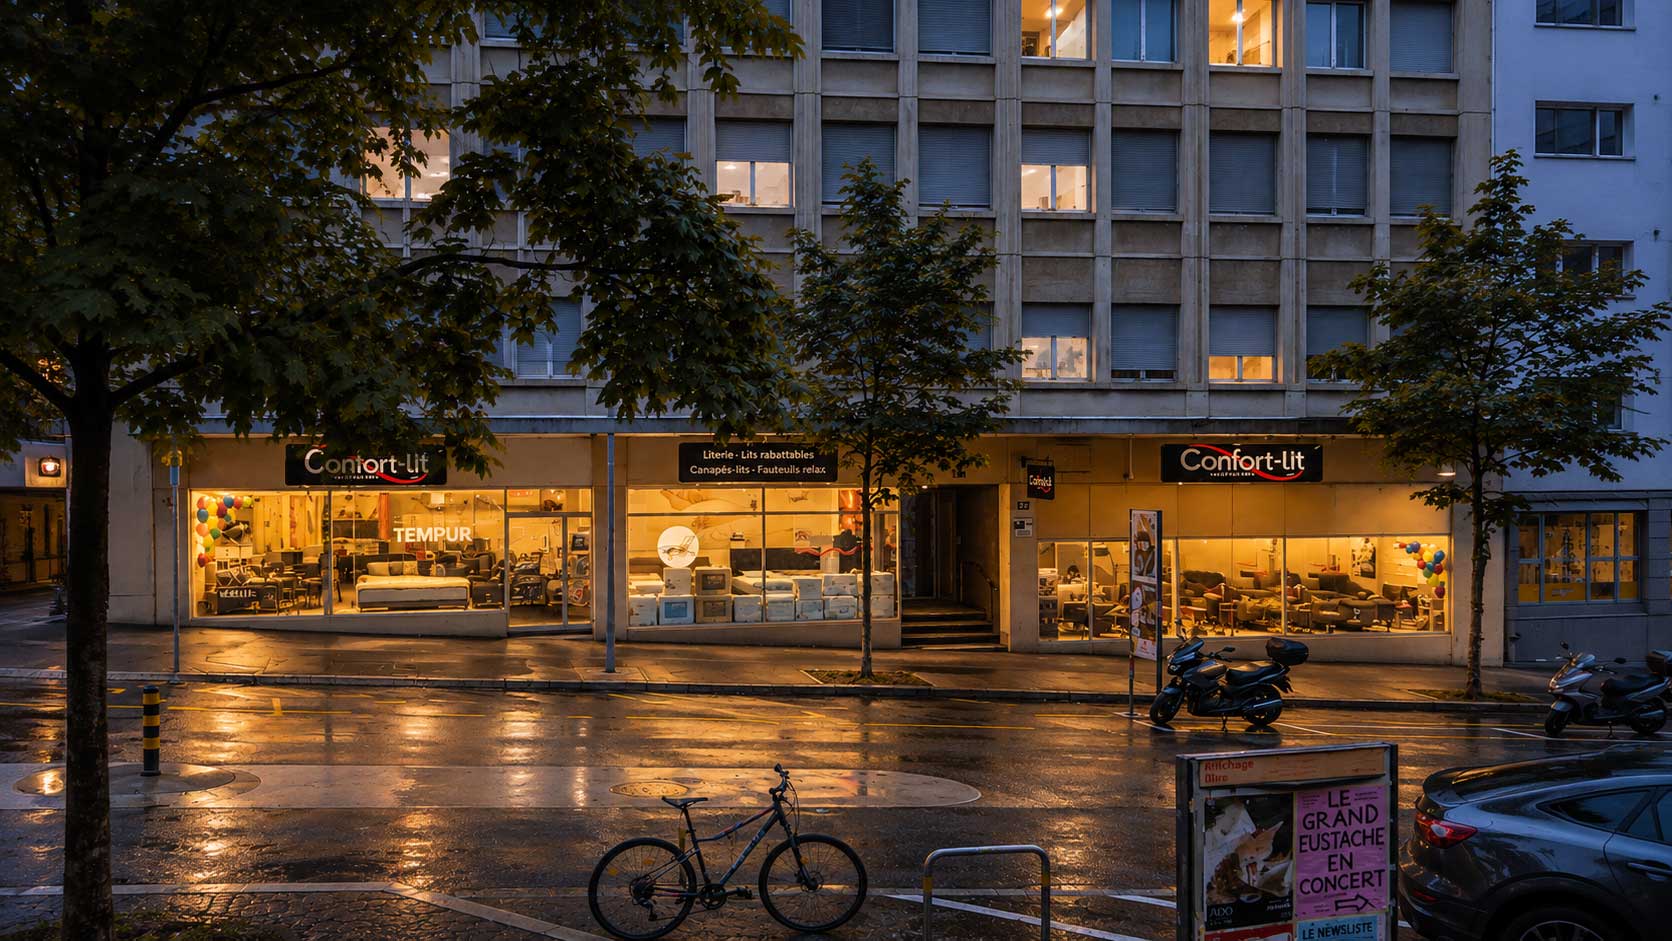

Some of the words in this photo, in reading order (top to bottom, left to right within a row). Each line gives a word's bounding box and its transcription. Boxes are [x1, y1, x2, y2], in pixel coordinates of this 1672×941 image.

[304, 448, 429, 474] Confort-lit
[703, 450, 734, 459] Literie
[741, 450, 758, 459] Lits
[760, 450, 815, 459] rabattables
[1180, 448, 1305, 471] Confort-lit
[689, 465, 750, 476] Canapés-lits
[757, 465, 800, 474] Fauteuils
[802, 465, 826, 474] relax
[393, 527, 473, 542] TEMPUR
[1328, 790, 1351, 808] LE
[1302, 804, 1379, 830] GRAND
[1299, 827, 1385, 853] EUSTACHE
[1328, 852, 1353, 872] EN
[1299, 869, 1385, 895] CONCERT
[1302, 928, 1314, 940] LE
[1317, 922, 1373, 938] NEWSLISTE
